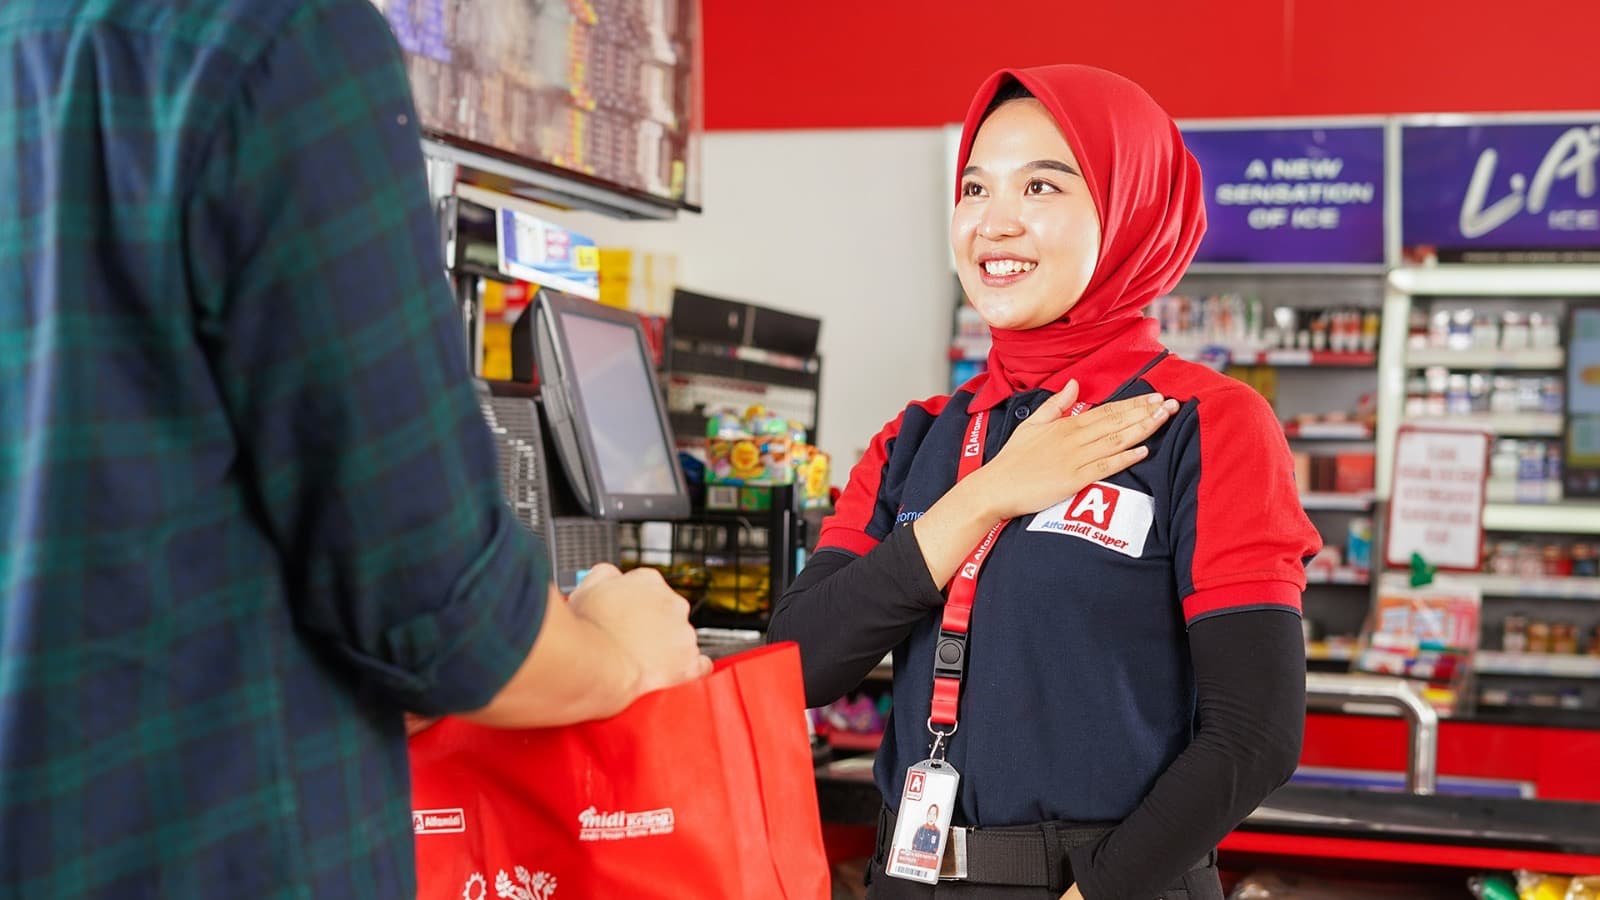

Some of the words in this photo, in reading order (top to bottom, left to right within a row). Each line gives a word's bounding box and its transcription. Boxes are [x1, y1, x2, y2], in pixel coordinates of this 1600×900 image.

[1244, 158, 1268, 180] A
[1271, 157, 1344, 180] NEW
[1215, 182, 1375, 206] SENSATION
[1247, 206, 1289, 230] OF
[1291, 206, 1341, 230] ICE
[1041, 520, 1092, 537] Alfamidi
[1091, 531, 1129, 550] super
